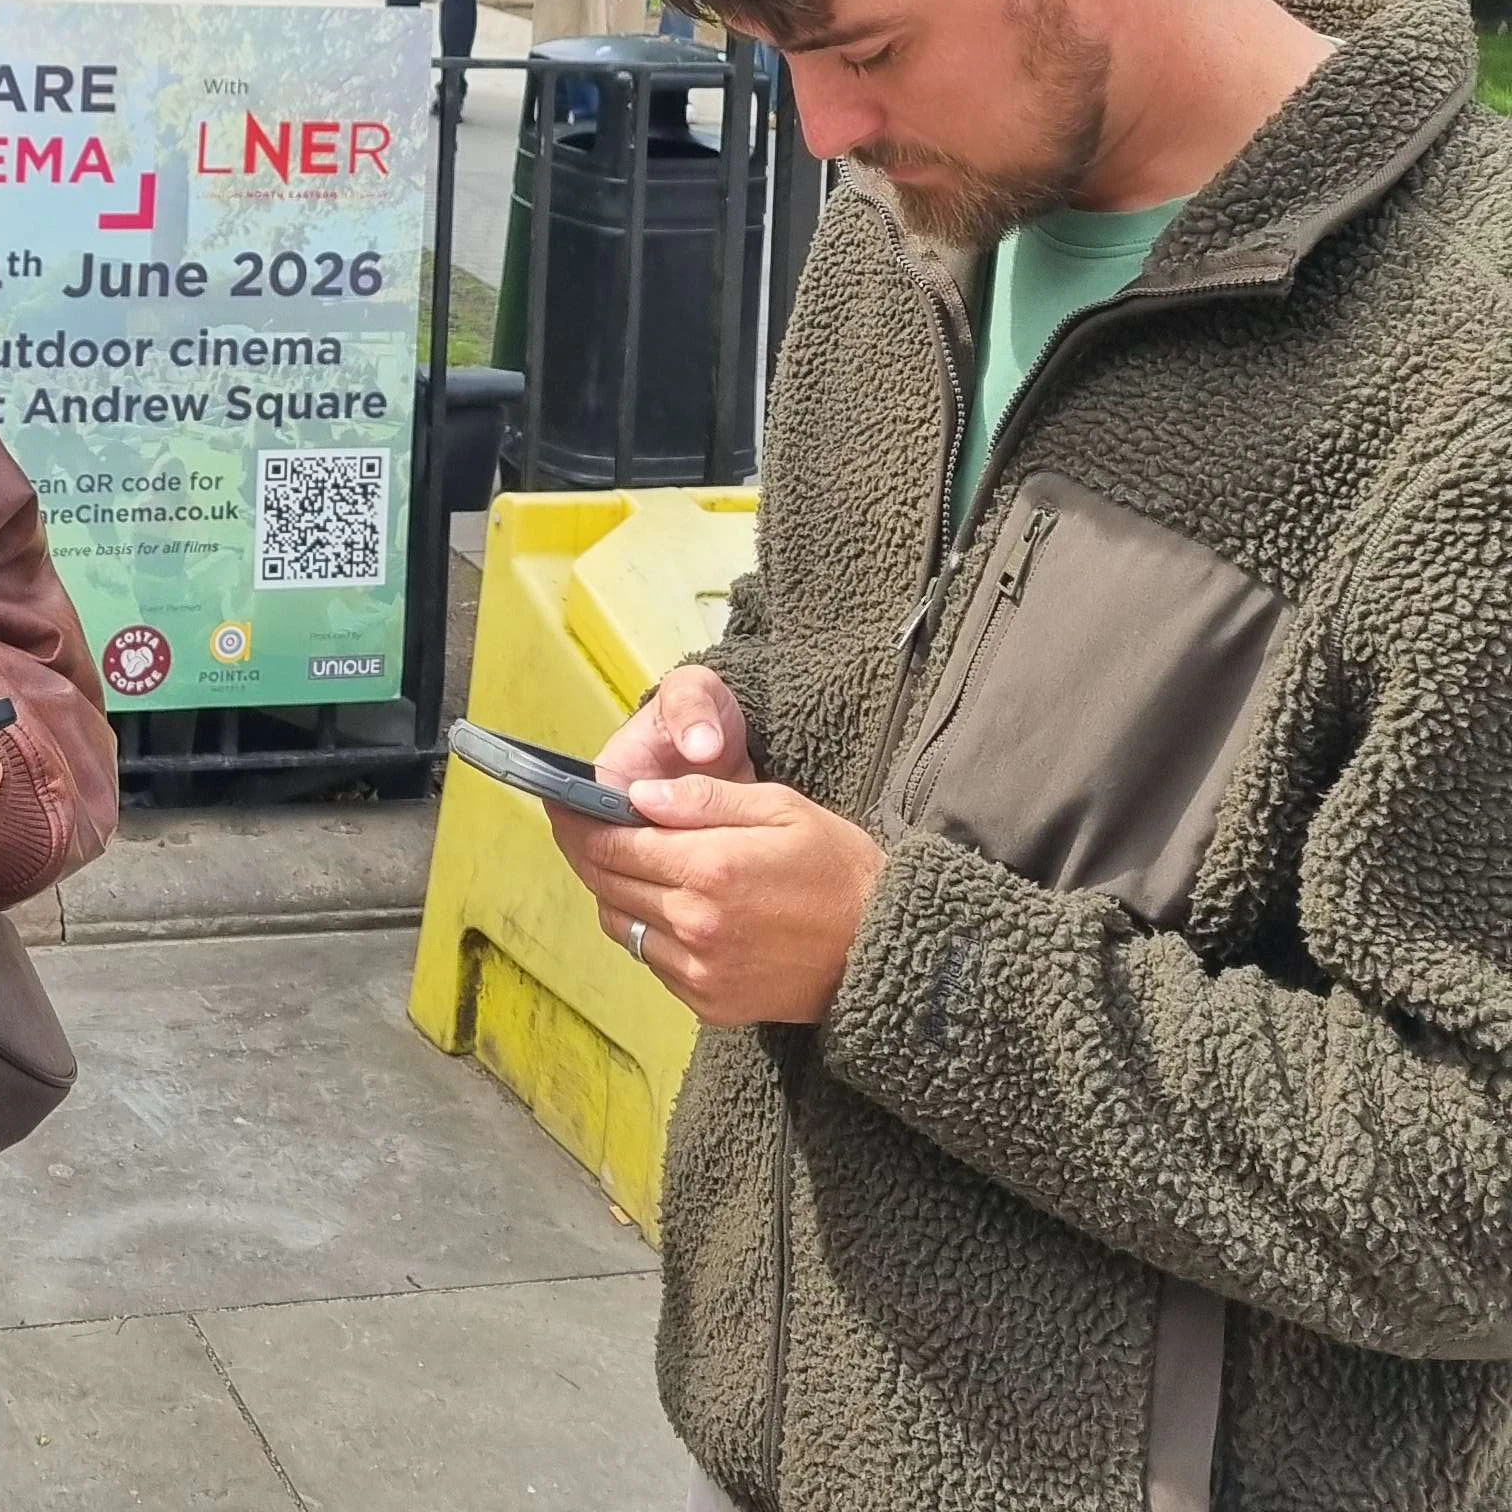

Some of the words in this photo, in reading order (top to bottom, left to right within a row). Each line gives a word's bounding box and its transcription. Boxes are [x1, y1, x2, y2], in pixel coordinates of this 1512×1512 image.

[204, 78, 248, 95] With
[198, 110, 390, 185] LNER
[63, 252, 208, 299] June
[231, 251, 383, 297] 2026
[169, 328, 342, 367] cinema
[23, 385, 208, 424] Andrew
[226, 385, 387, 427] Square
[76, 474, 114, 493] QR
[121, 472, 181, 492] code
[190, 471, 223, 491] for
[52, 546, 91, 557] serve
[95, 543, 133, 556] basis
[137, 543, 159, 556] for
[163, 541, 179, 554] all
[184, 541, 219, 554] films
[115, 630, 159, 649] COSTA
[110, 670, 163, 692] COFFEE
